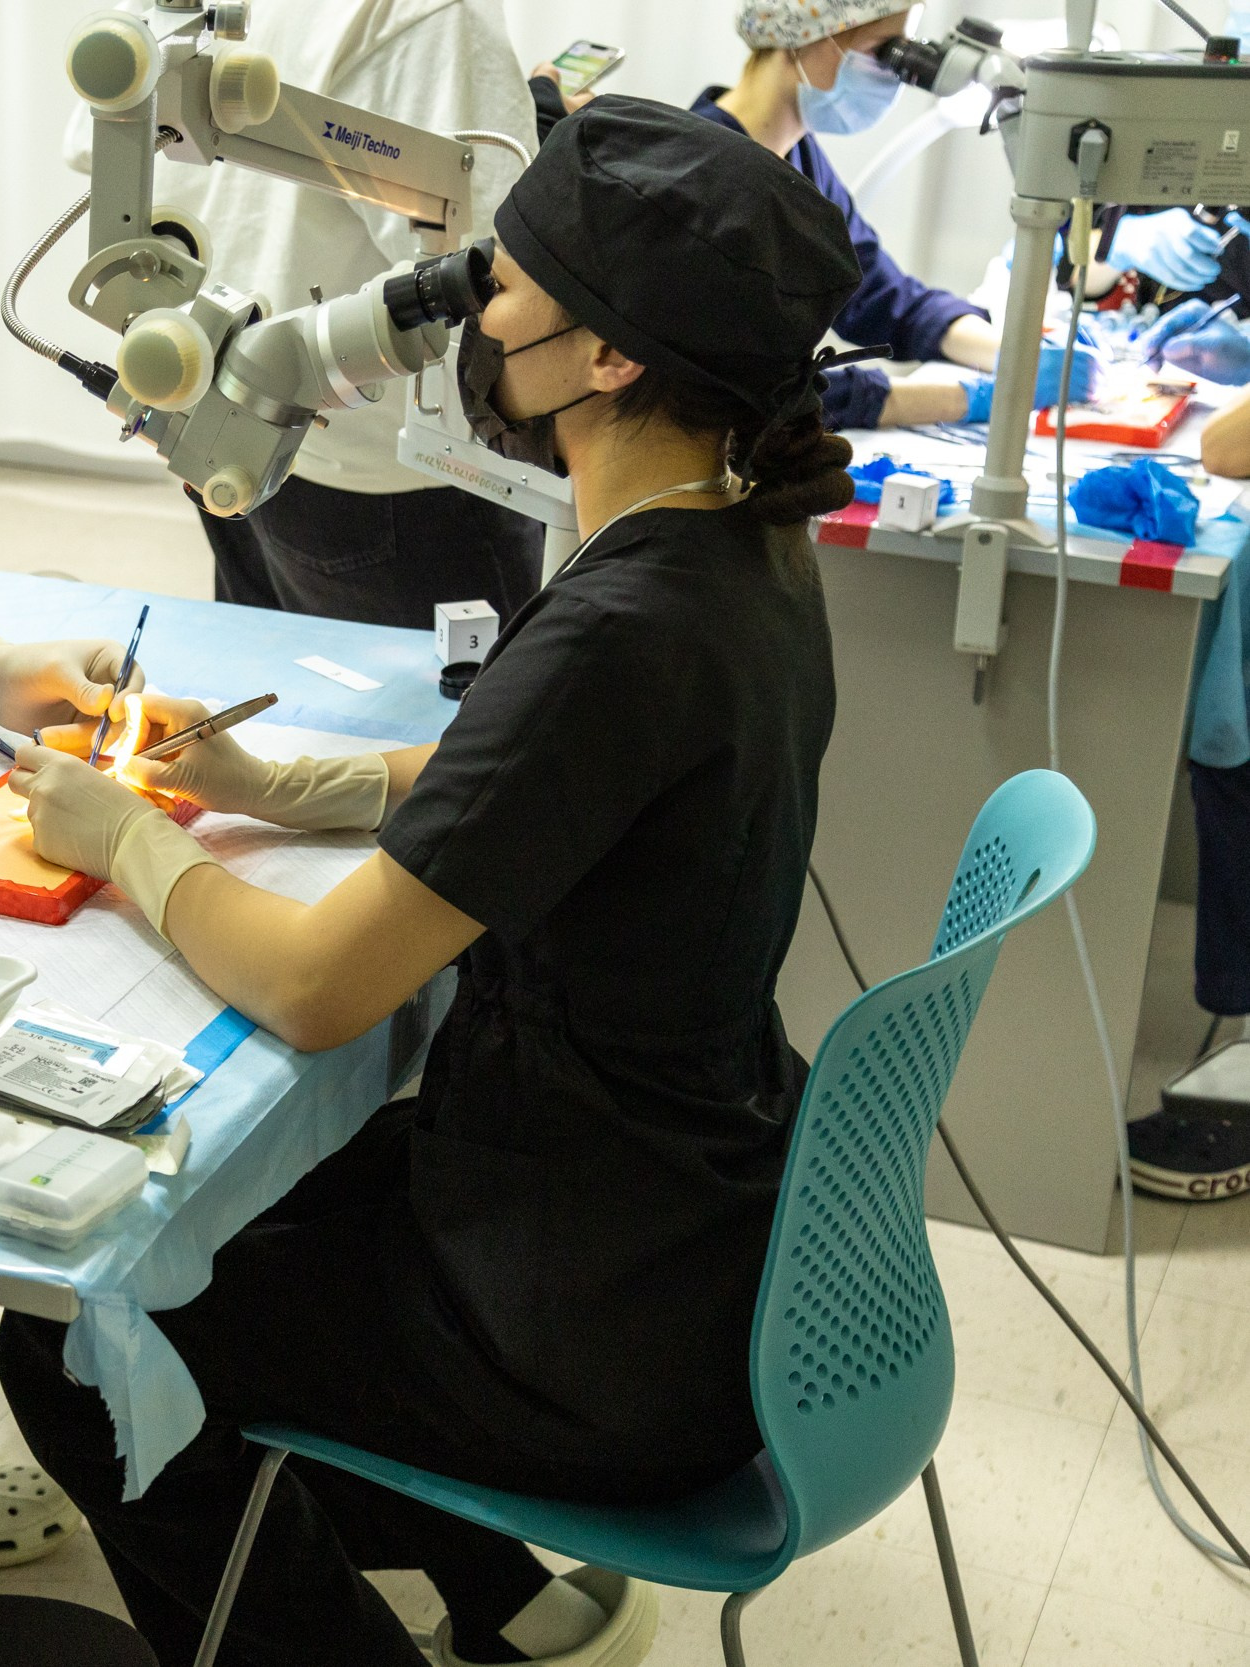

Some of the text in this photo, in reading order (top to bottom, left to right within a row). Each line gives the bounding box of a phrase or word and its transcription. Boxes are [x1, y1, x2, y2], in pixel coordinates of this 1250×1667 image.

[335, 125, 401, 160] Meiji Techno
[898, 495, 905, 509] 1
[469, 635, 479, 649] 3
